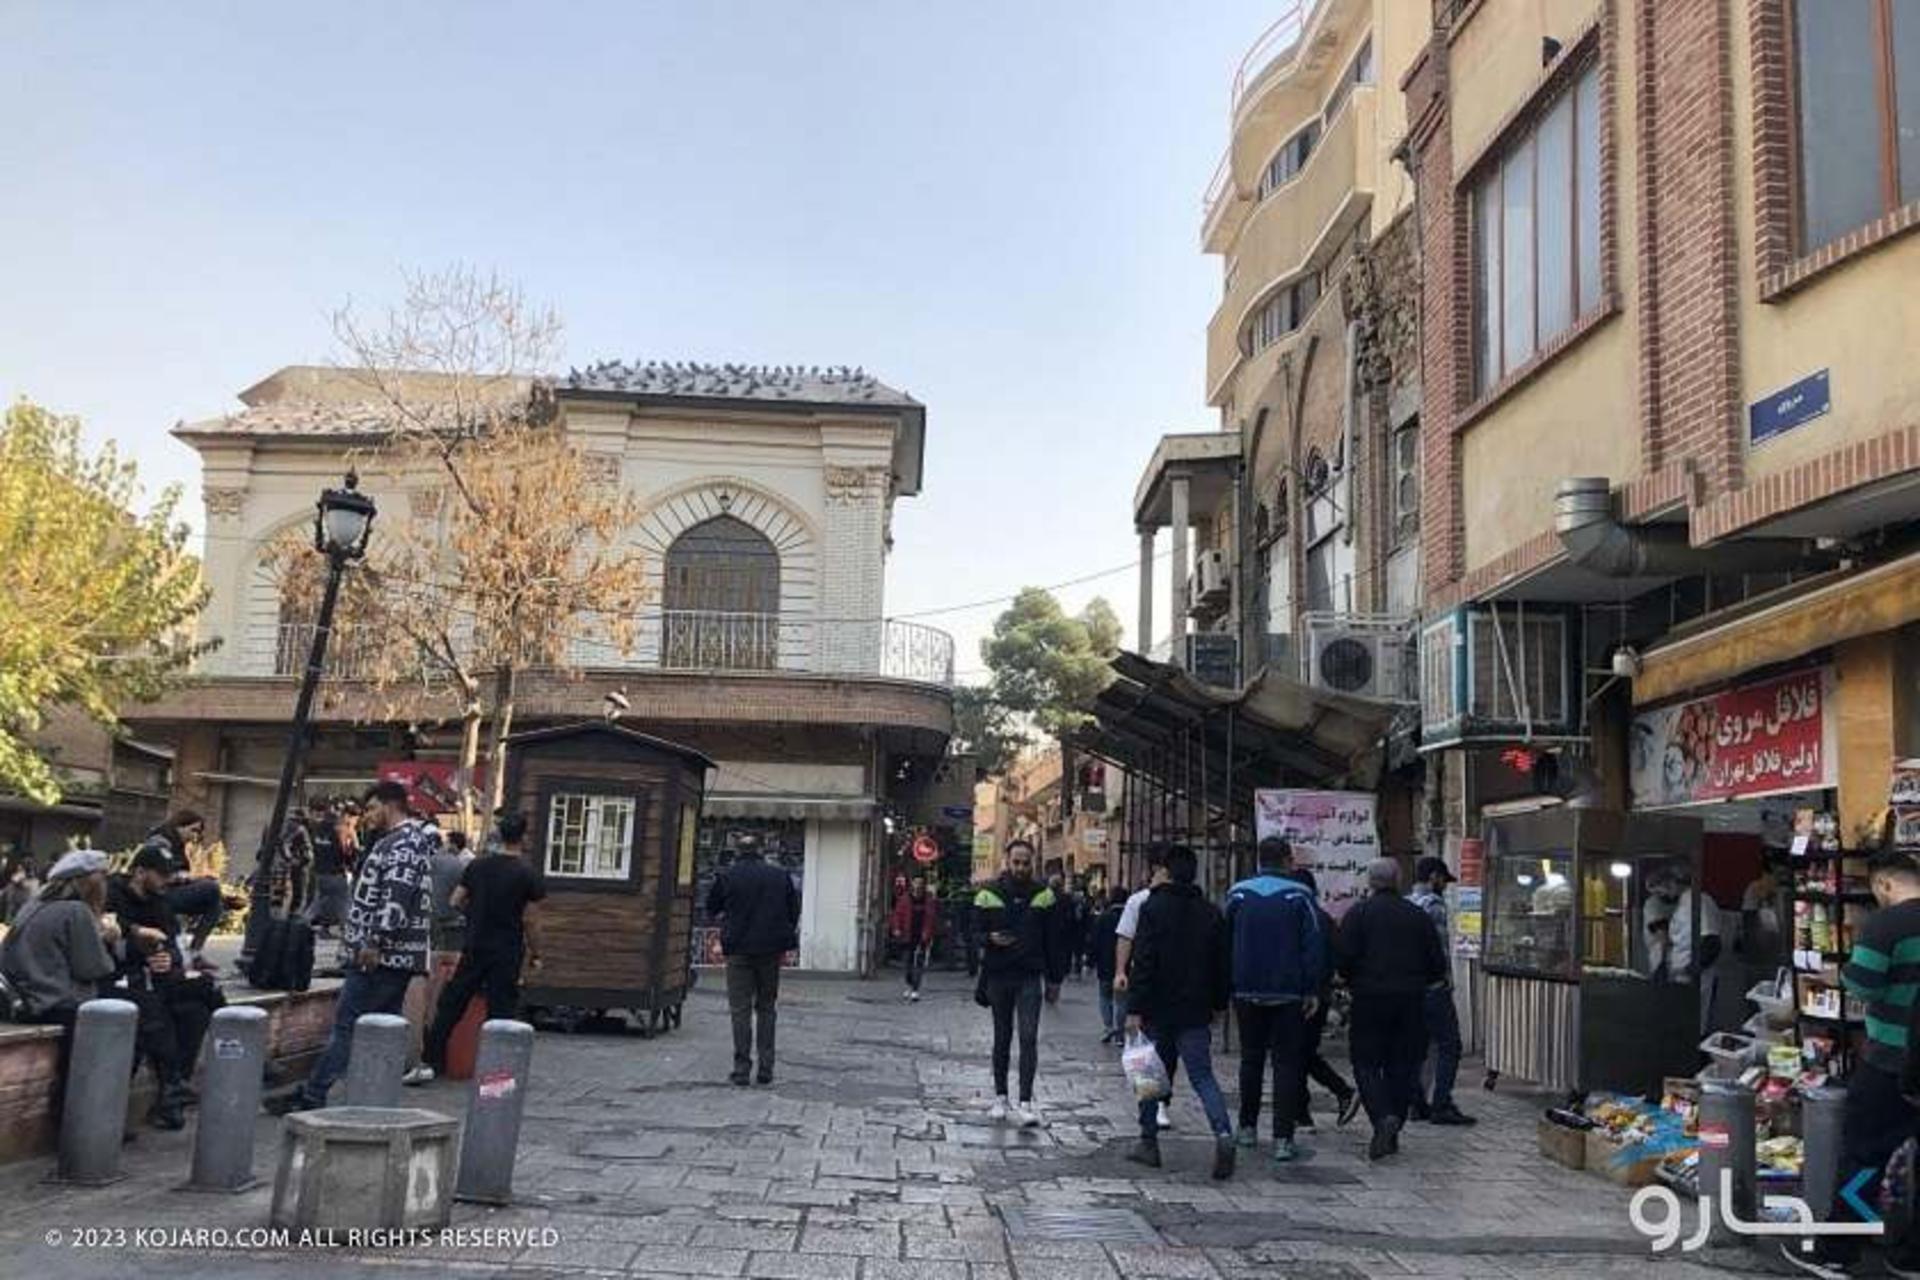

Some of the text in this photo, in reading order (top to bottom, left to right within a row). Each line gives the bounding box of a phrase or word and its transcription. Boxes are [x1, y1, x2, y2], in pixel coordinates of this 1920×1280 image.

[1766, 682, 1819, 735] فلافل
[1714, 740, 1819, 787] اولین فلافل تهران
